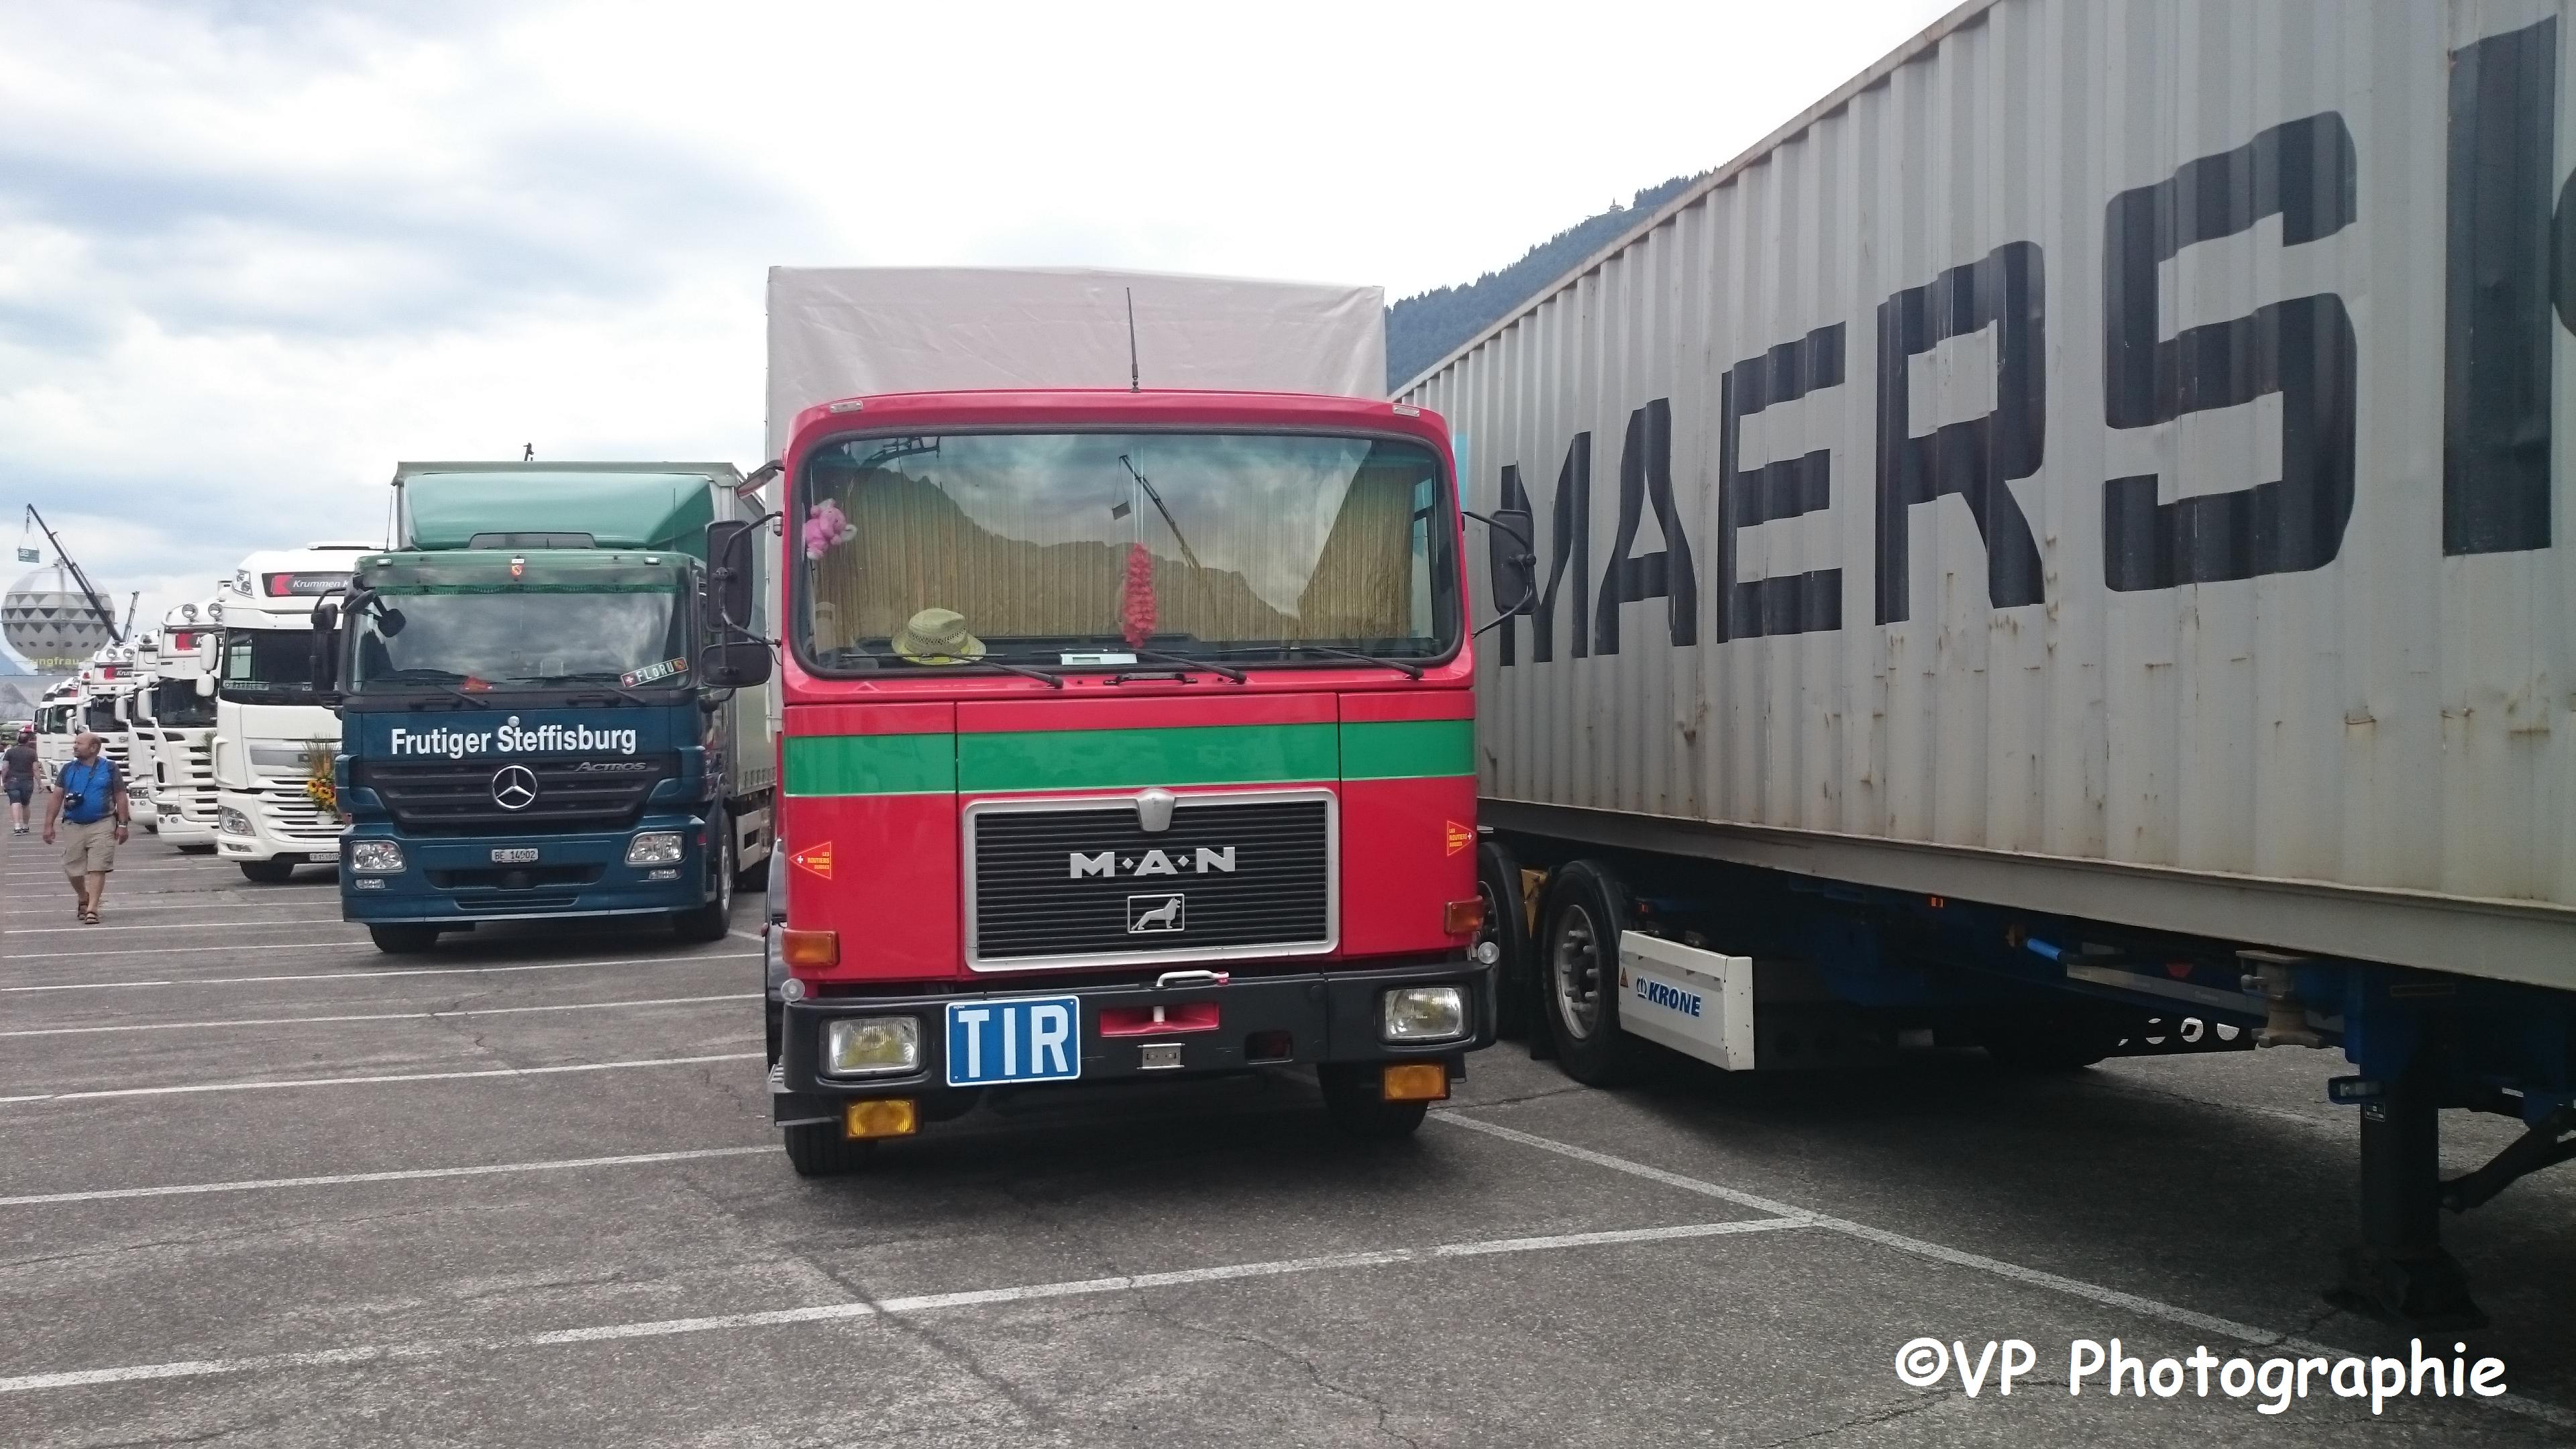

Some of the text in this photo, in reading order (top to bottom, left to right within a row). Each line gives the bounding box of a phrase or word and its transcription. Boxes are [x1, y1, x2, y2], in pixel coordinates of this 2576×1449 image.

[293, 580, 340, 588] Krummen
[636, 661, 675, 682] FLORU
[391, 724, 637, 759] Frutiger Steffisburg
[494, 851, 506, 860] BE
[1648, 980, 1702, 1017] KRONE
[958, 1004, 1069, 1078] TIR
